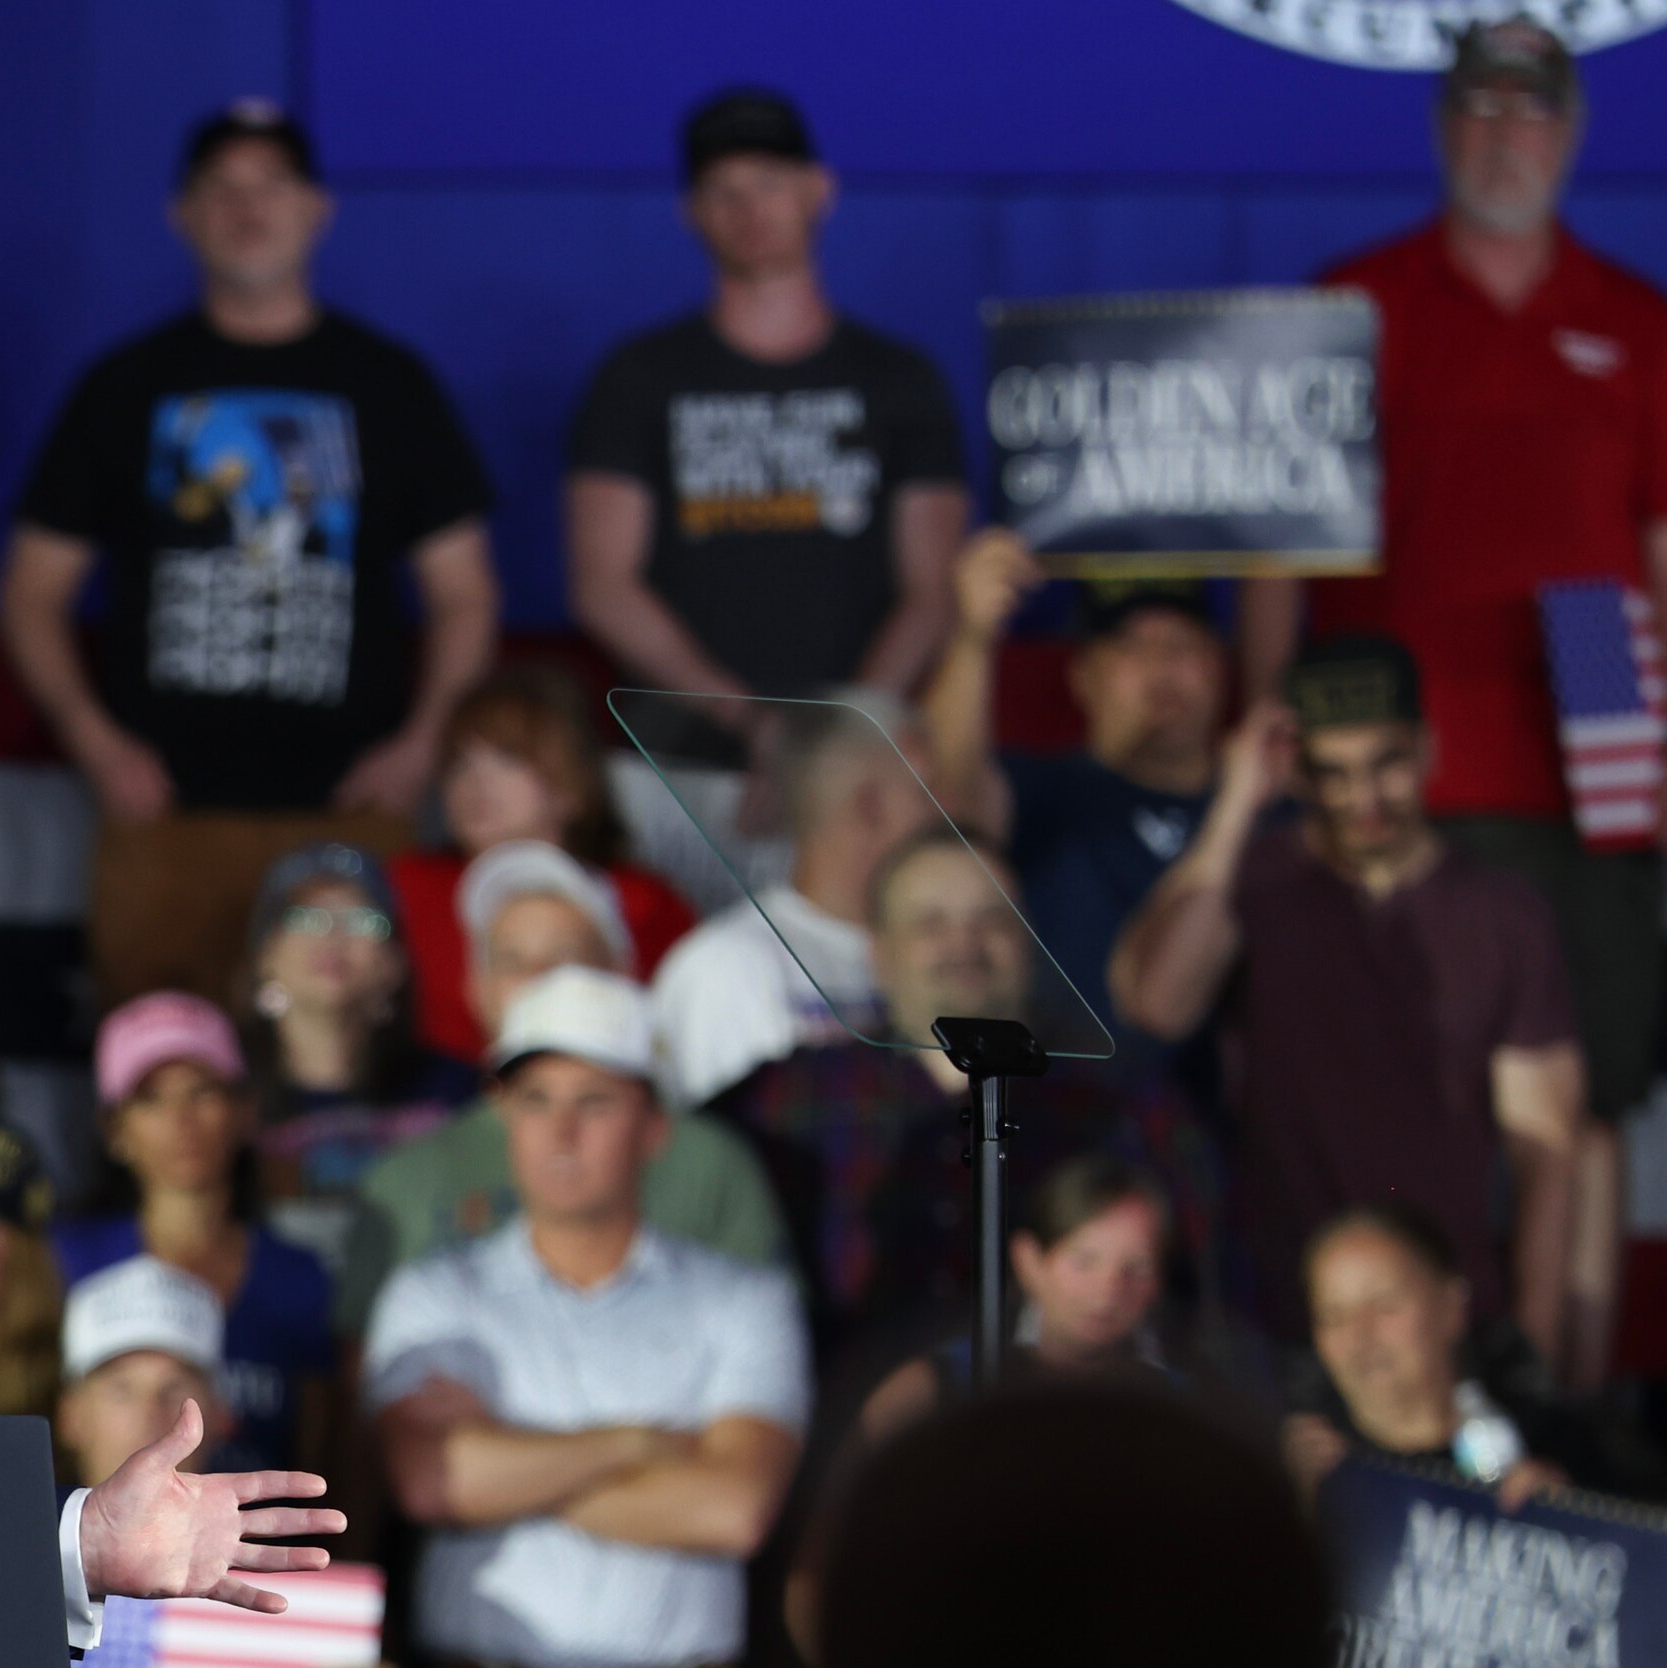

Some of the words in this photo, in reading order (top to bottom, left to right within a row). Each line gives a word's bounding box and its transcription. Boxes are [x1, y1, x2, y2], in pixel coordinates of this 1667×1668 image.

[987, 358, 1239, 452] GOLDEN
[1249, 355, 1377, 444] AGE
[1069, 436, 1359, 517] AMERICA
[1399, 1499, 1629, 1618] MAKING
